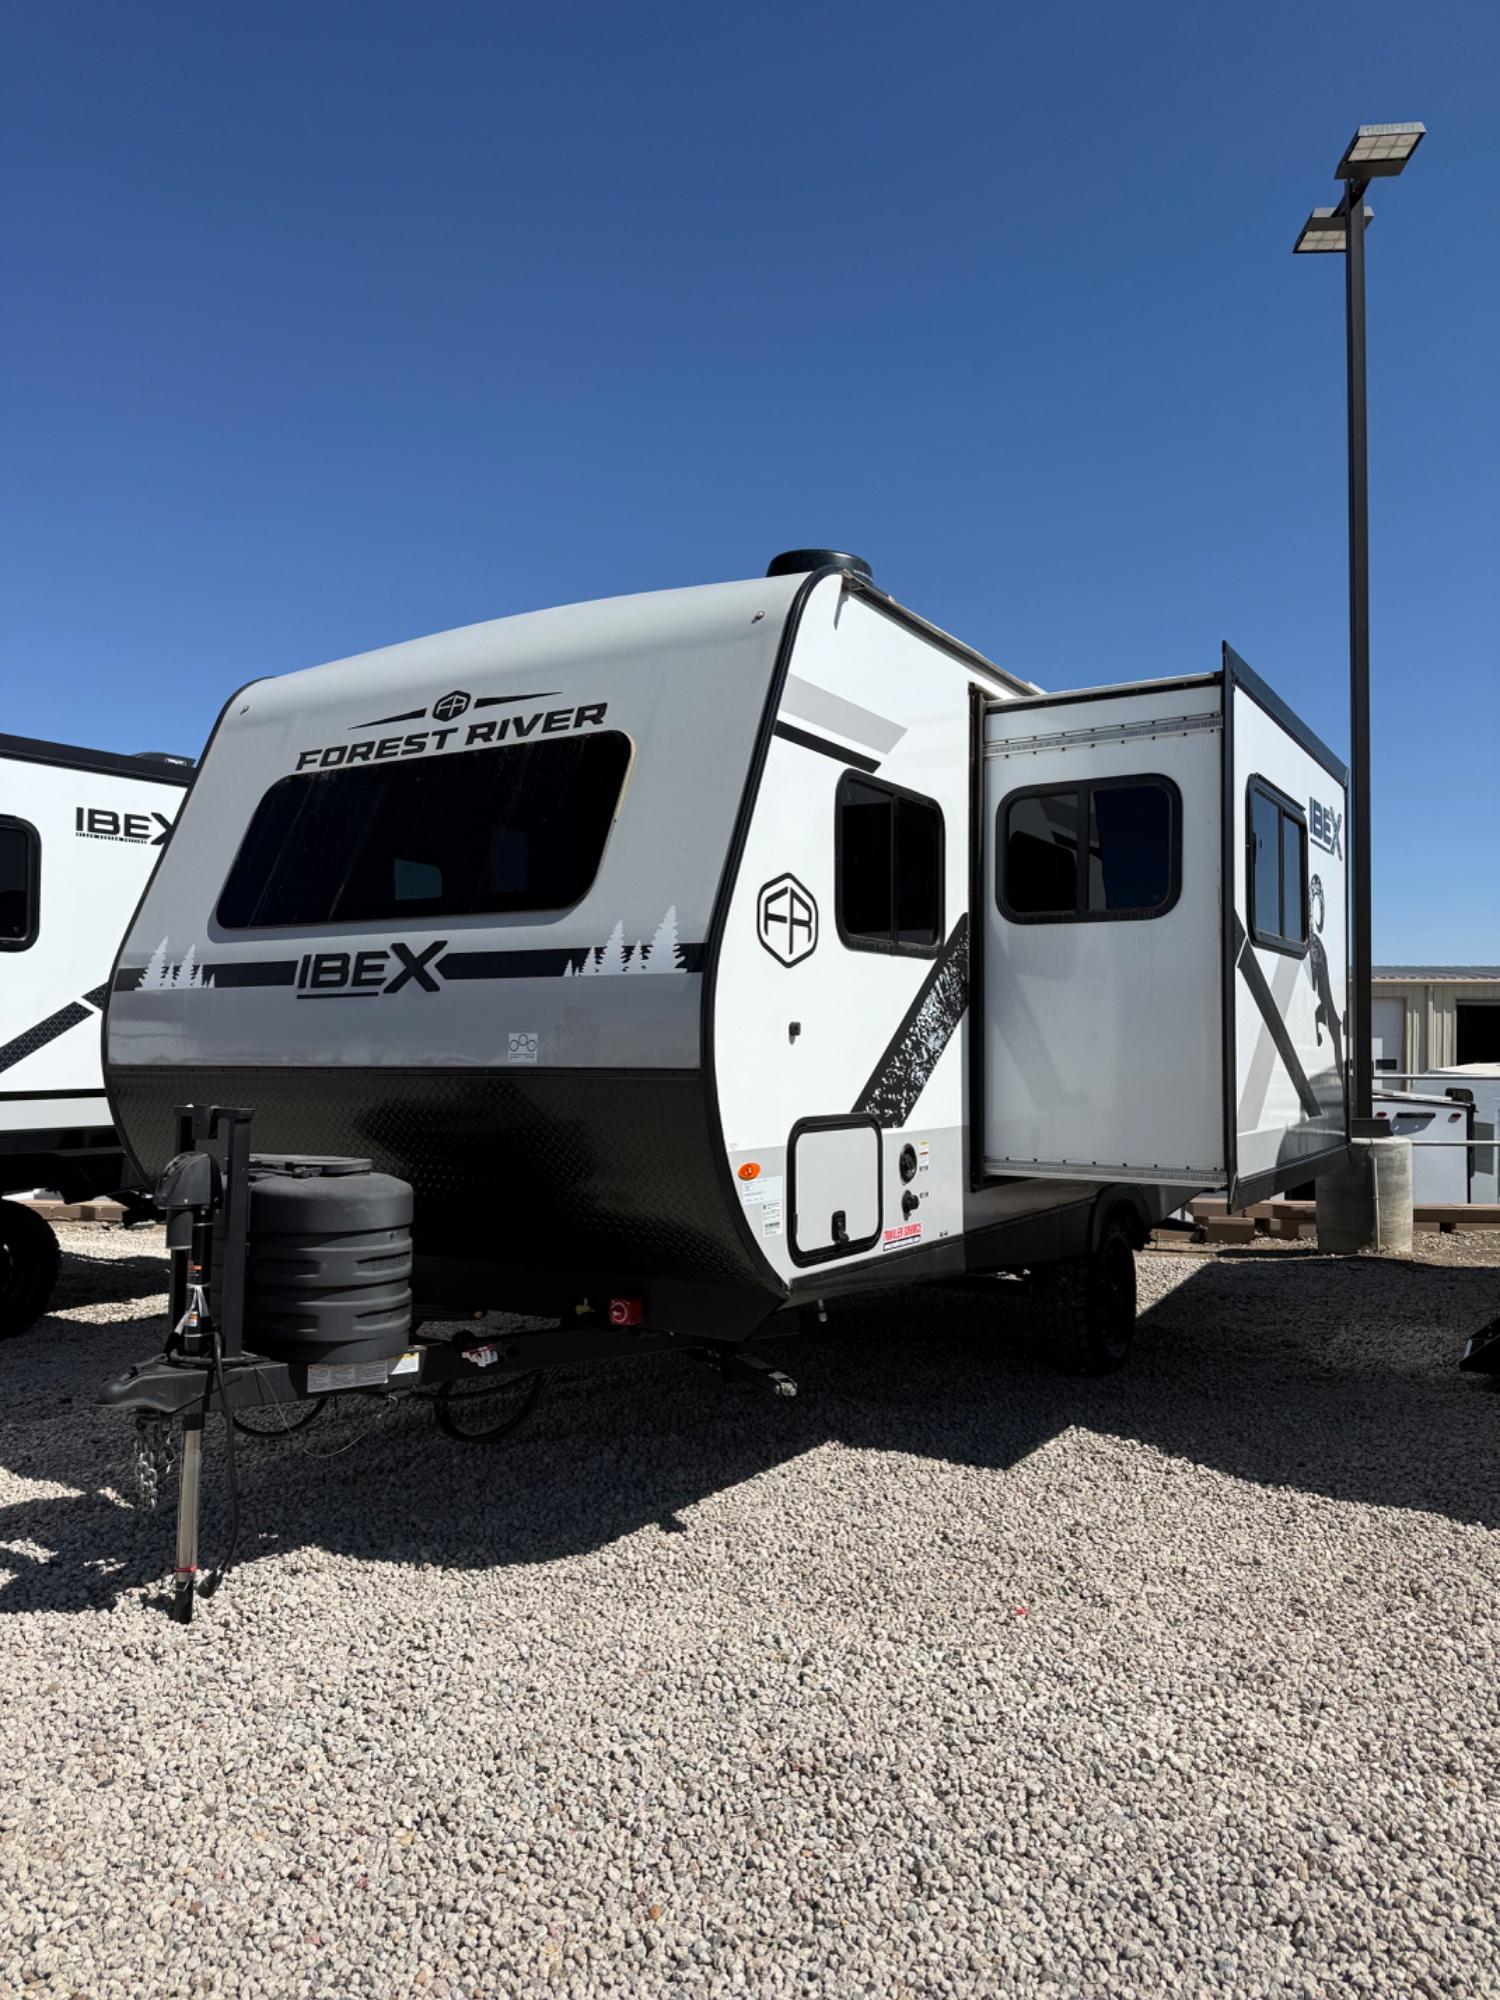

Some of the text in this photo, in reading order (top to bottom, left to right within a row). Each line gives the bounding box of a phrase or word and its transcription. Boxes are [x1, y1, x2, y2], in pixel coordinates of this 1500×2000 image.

[295, 702, 608, 771] FOREST RIVER
[1309, 796, 1343, 862] IBEX
[297, 940, 448, 994] IBEX
